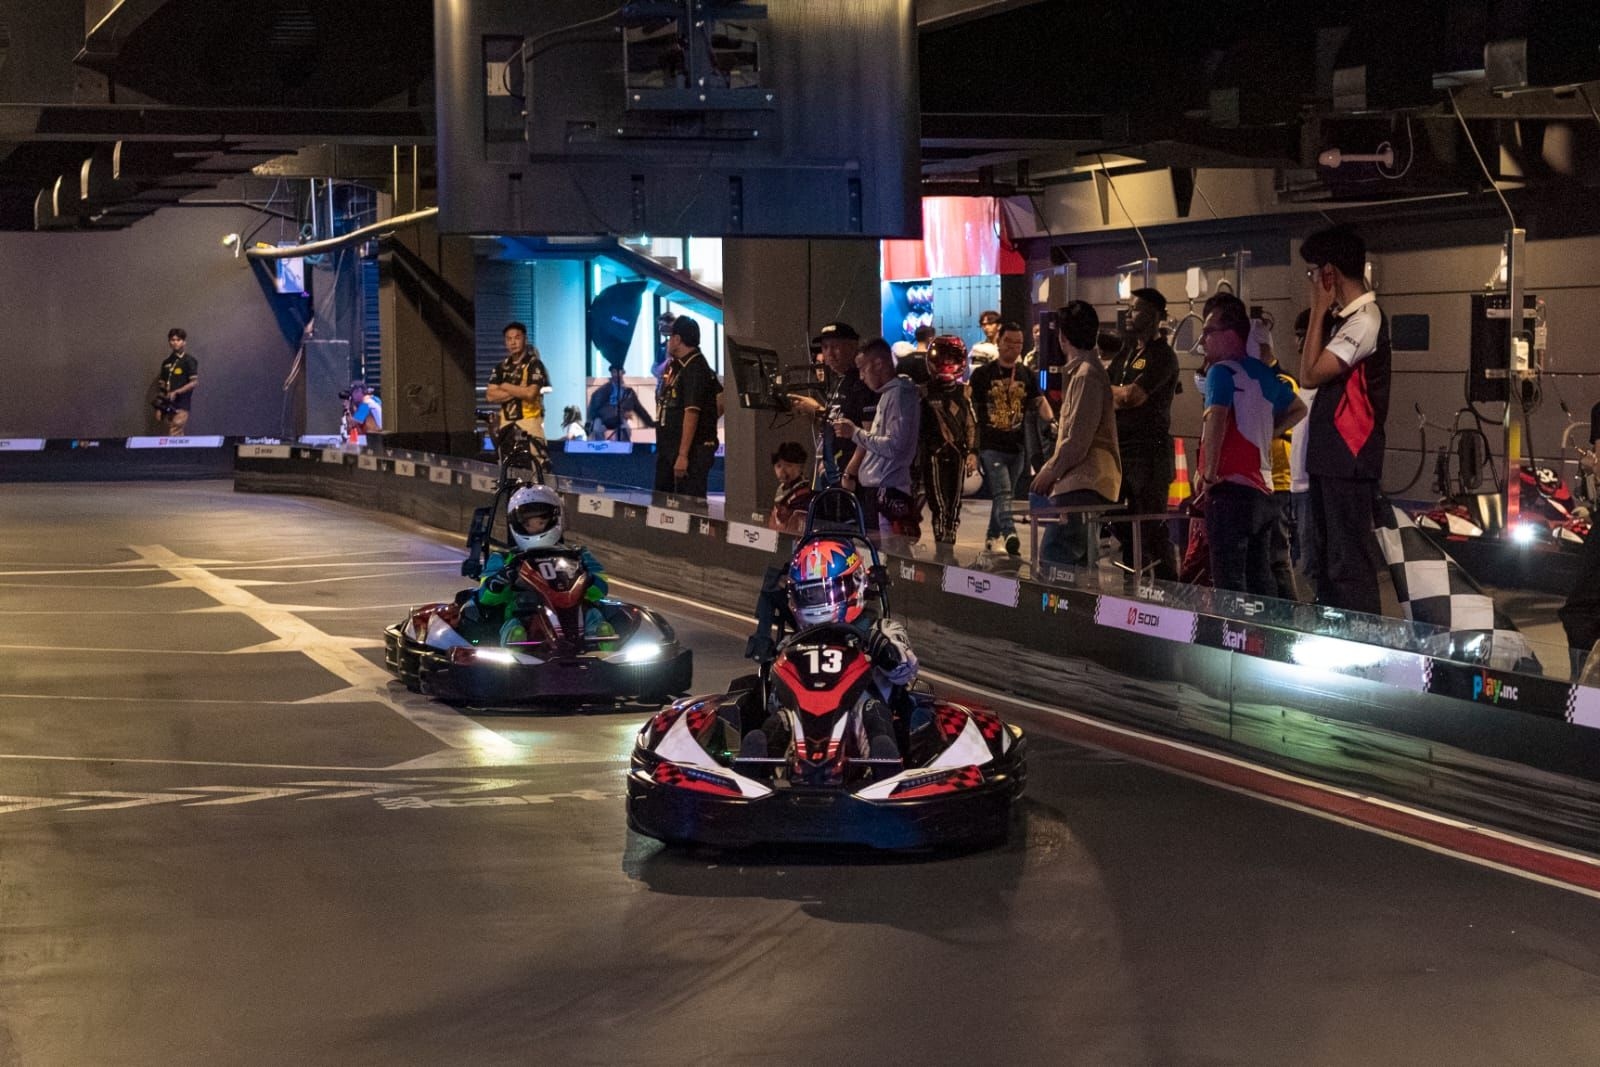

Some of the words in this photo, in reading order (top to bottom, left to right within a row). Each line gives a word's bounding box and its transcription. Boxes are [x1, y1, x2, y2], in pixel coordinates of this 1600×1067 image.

[1138, 612, 1160, 627] SODI
[802, 649, 843, 674] 13
[1473, 669, 1519, 704] play.inc
